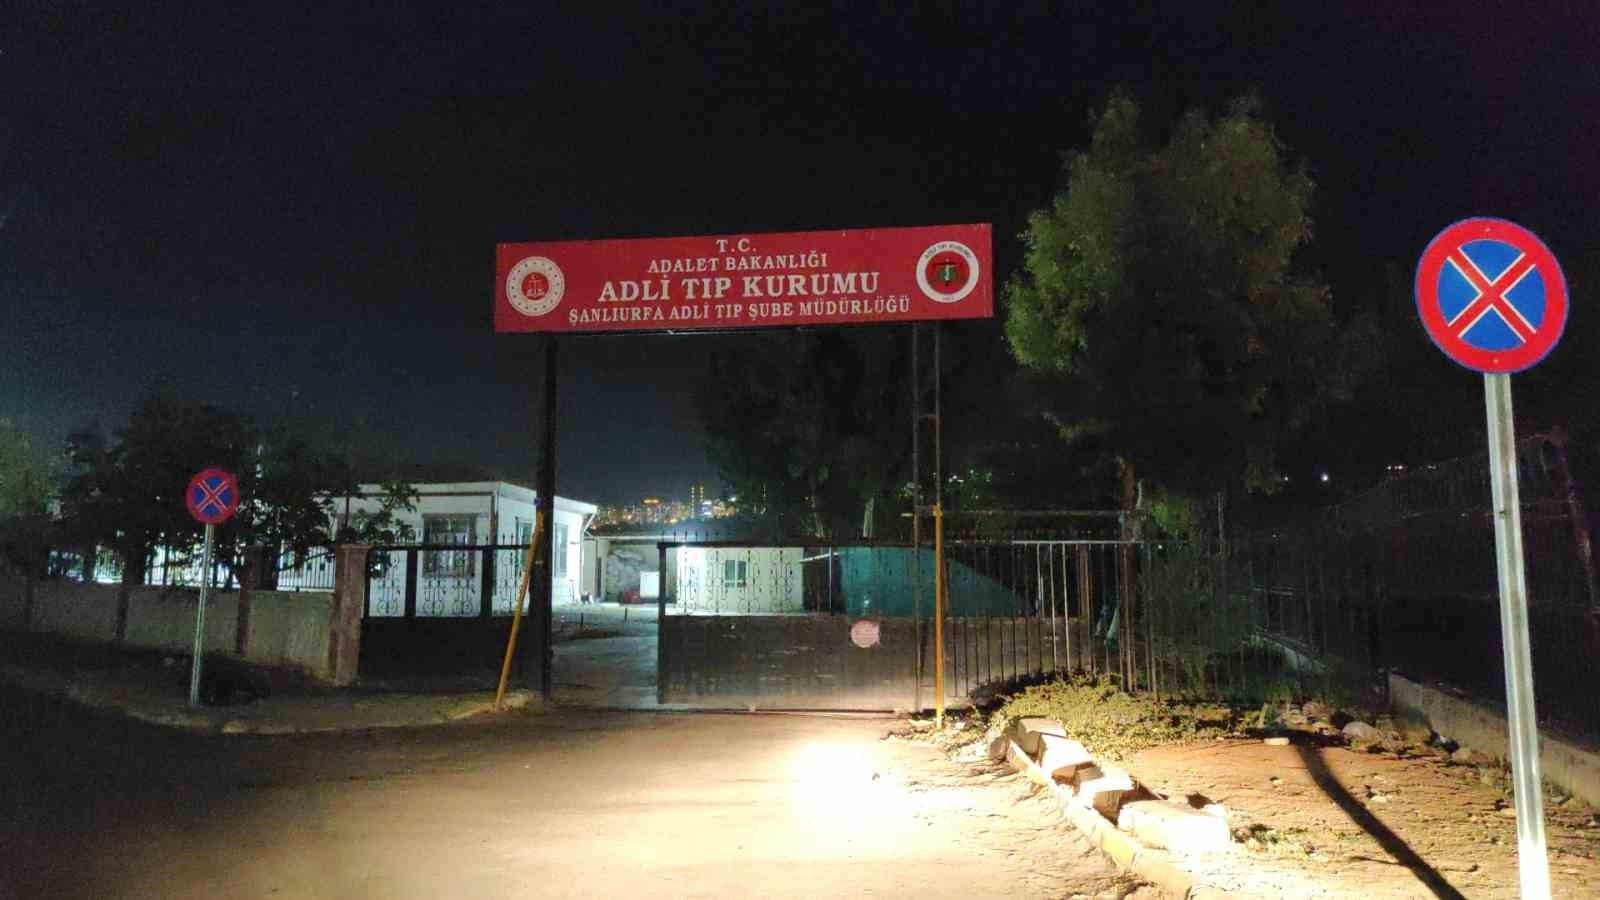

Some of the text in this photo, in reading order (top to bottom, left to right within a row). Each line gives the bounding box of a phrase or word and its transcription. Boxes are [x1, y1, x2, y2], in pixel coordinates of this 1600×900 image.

[716, 238, 755, 253] T.C.
[648, 250, 828, 274] ADALET BAKANLIĞI
[598, 272, 881, 303] ADLİ TIP KURUMU
[568, 294, 912, 325] ŞANLIURFA ADLİ TIP ŞUBE MÜDÜRLÜĞÜ
